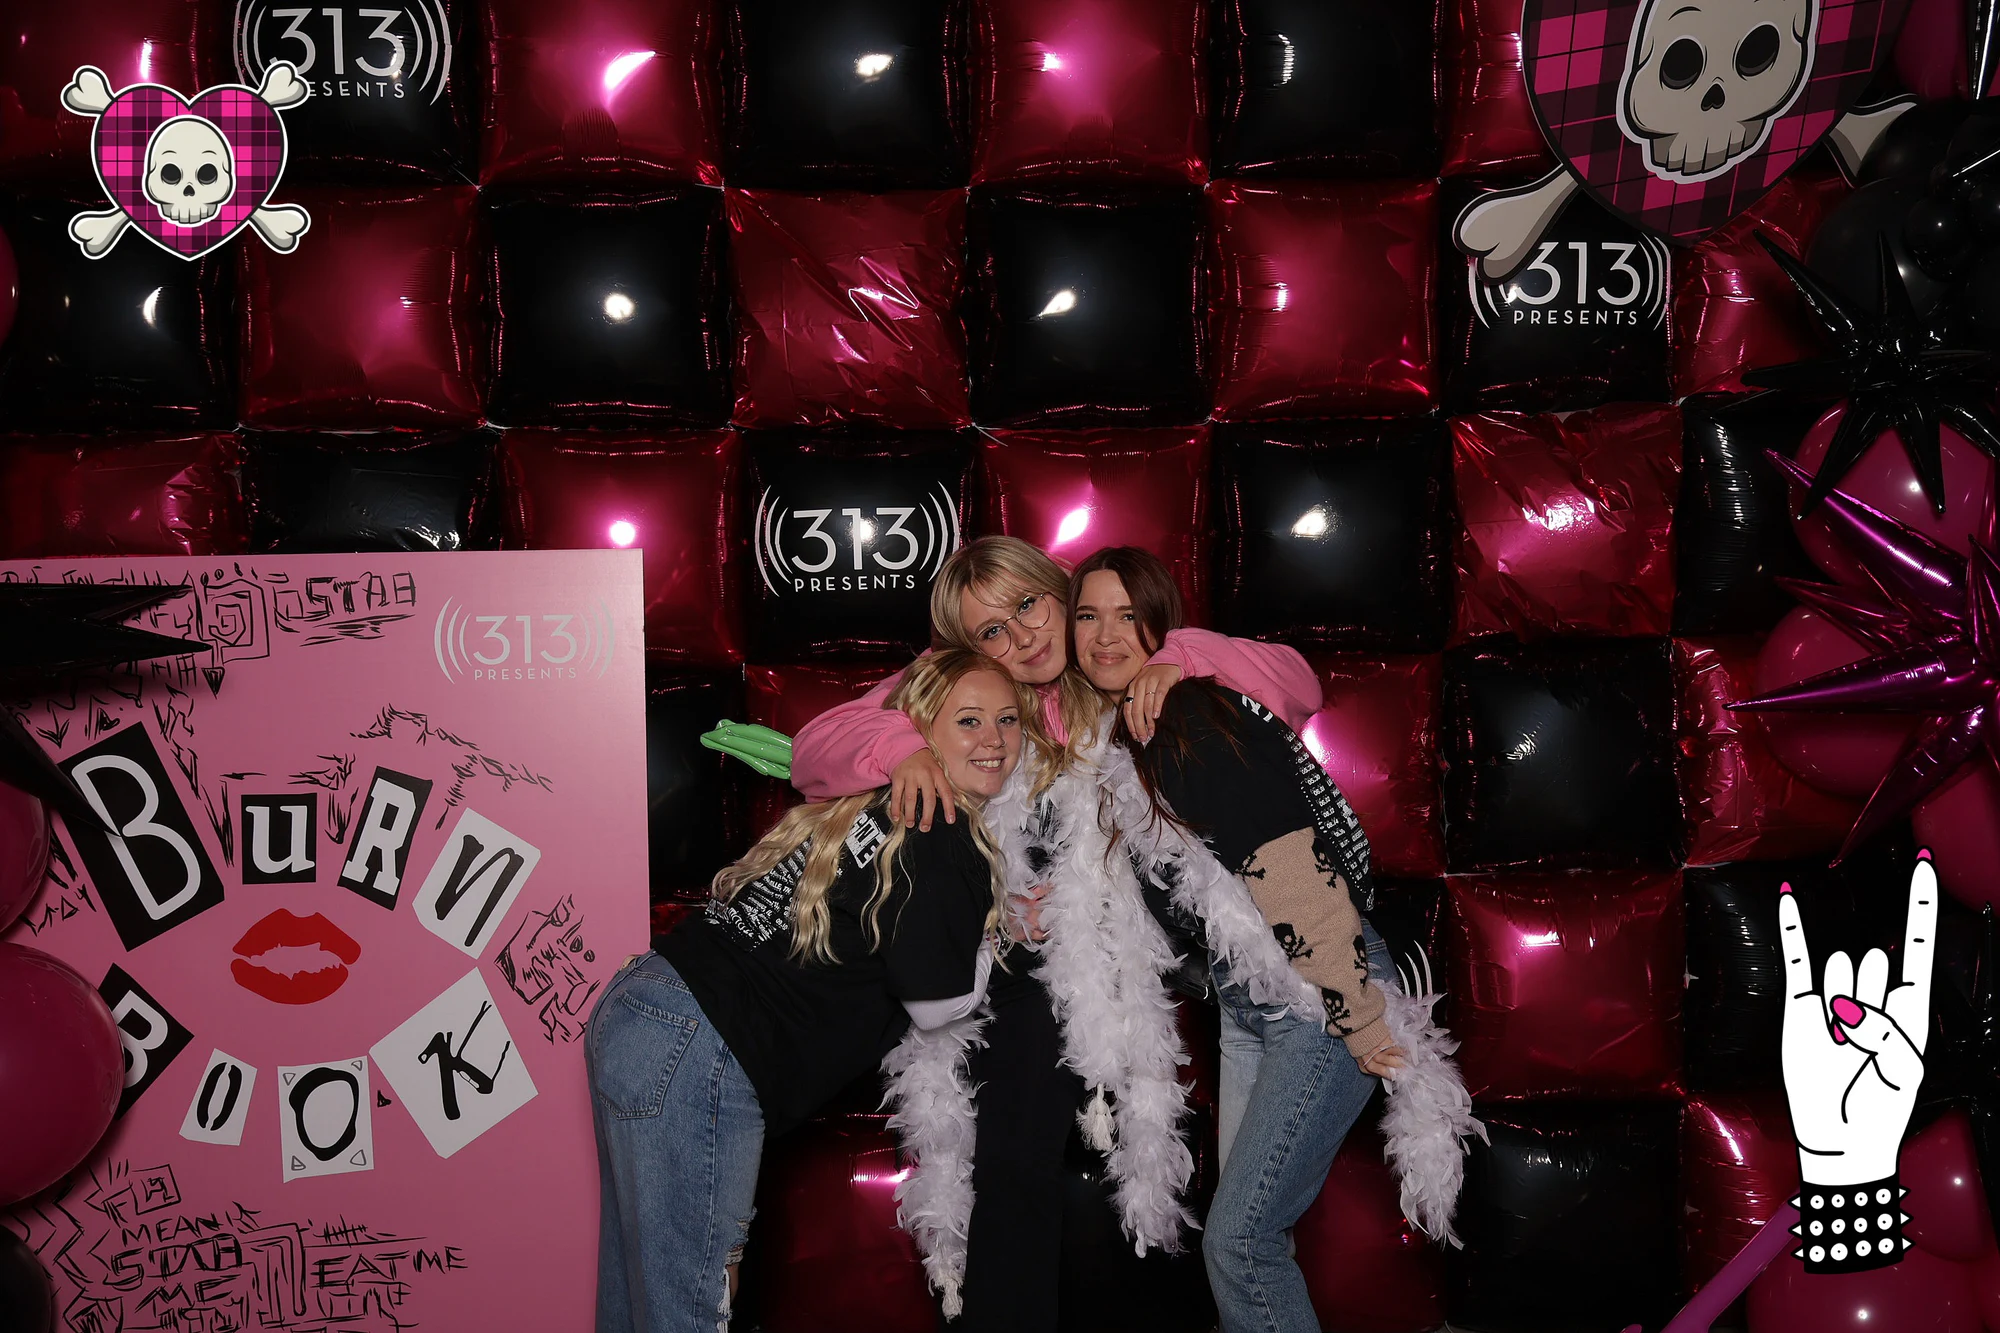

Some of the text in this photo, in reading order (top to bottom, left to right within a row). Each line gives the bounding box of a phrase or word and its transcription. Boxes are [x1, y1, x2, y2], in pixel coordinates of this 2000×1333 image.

[269, 7, 406, 77] 313
[309, 81, 405, 98] ESENTS
[1517, 241, 1641, 306] 313
[1513, 310, 1638, 325] PRESENTS
[791, 507, 919, 573] 313
[794, 574, 916, 593] PRESENTS
[472, 614, 578, 665] 313
[474, 667, 577, 681] PRESENTS
[413, 1246, 468, 1274] ME
